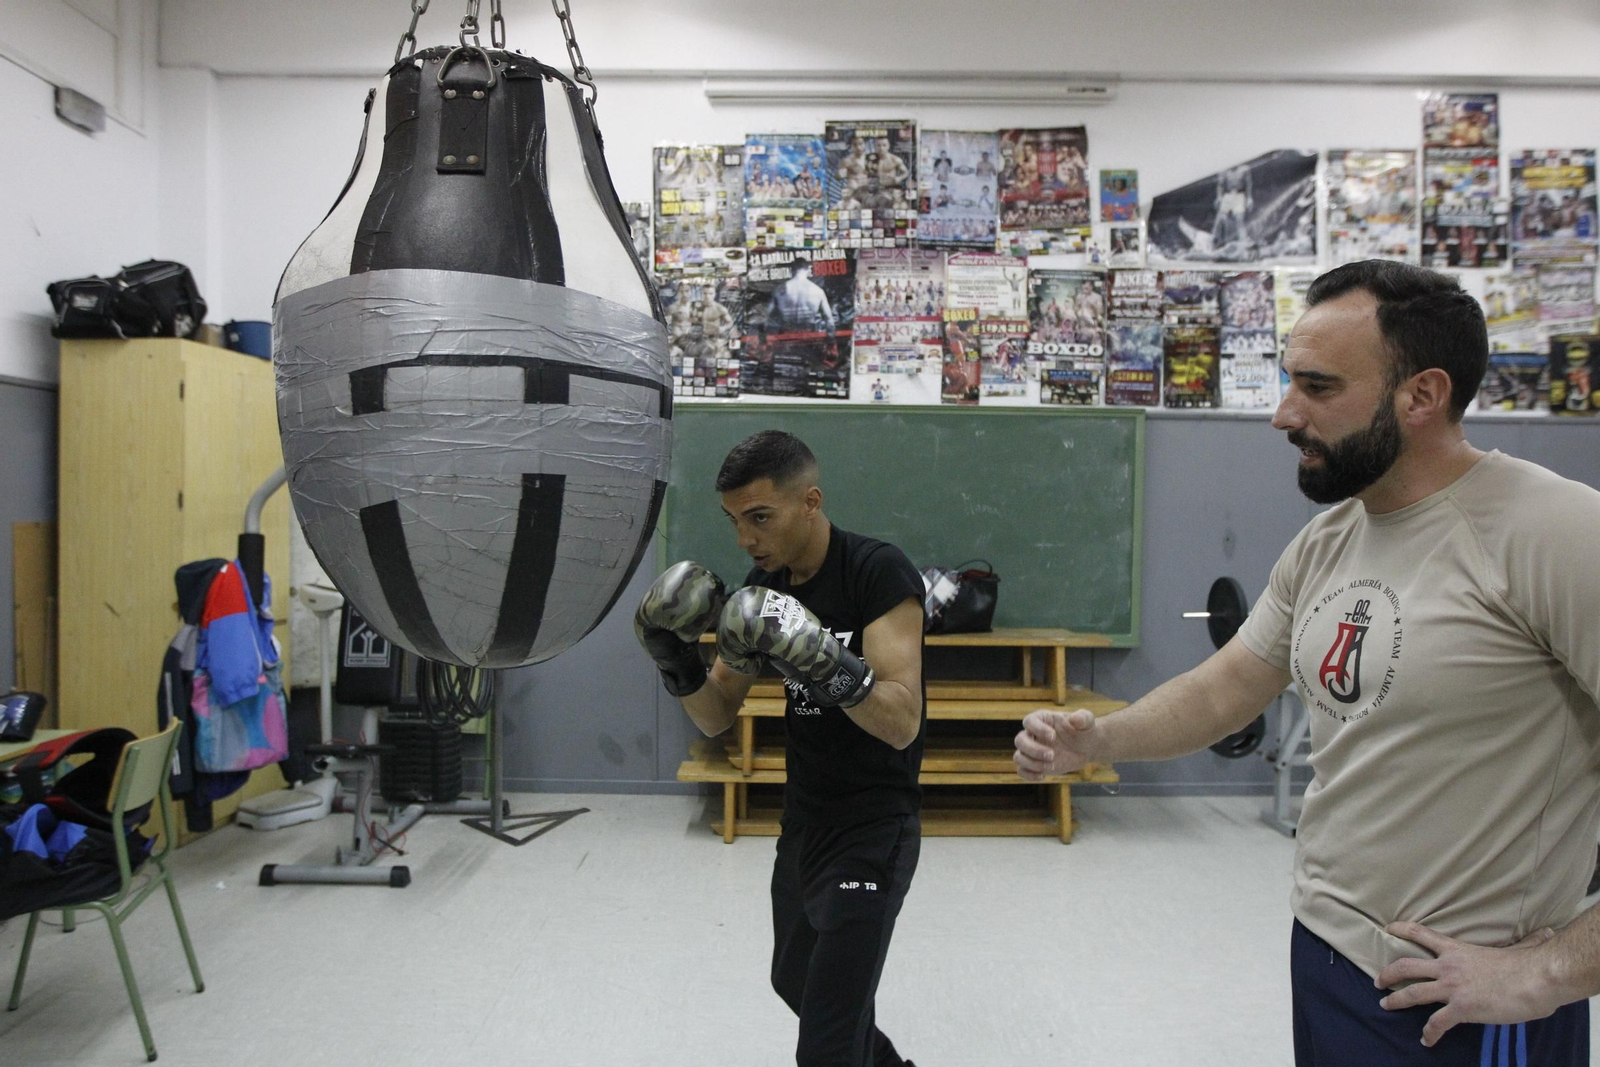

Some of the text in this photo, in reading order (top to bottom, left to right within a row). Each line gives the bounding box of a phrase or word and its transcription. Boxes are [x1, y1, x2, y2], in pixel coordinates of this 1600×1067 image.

[762, 250, 795, 265] BATALLA
[770, 266, 793, 280] BRUTA
[813, 261, 847, 276] BOXEO
[943, 309, 976, 322] BOXEO
[1027, 342, 1104, 356] BOXEO
[1321, 578, 1401, 615] TEAM ALMERÍA BOXING
[1391, 628, 1403, 660] TEAM
[1372, 666, 1396, 708] ALMERÍA
[1316, 700, 1338, 719] TEAM
